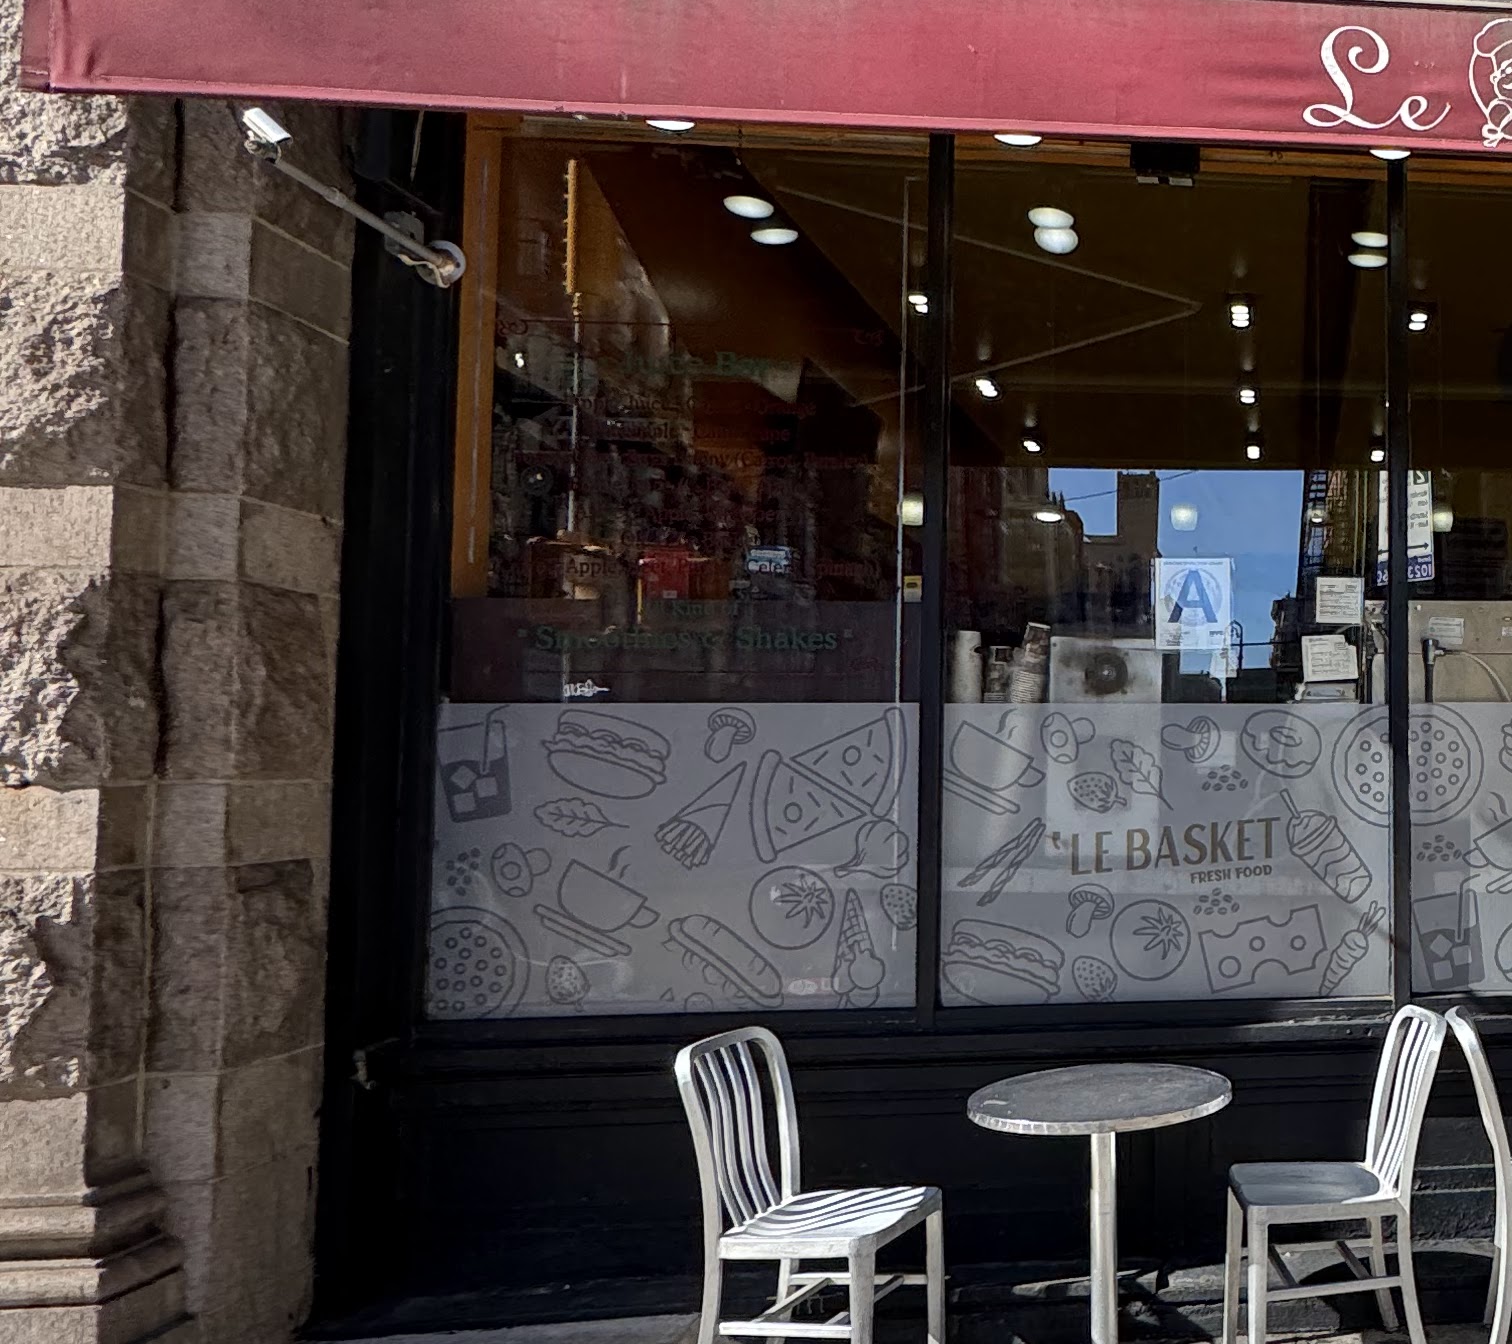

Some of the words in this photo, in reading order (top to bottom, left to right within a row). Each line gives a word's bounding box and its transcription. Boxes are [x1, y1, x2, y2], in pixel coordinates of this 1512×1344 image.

[1302, 25, 1450, 131] Le
[1167, 570, 1218, 623] A
[1126, 816, 1281, 871] BASKET
[1190, 869, 1232, 884] FRESH
[1235, 863, 1273, 879] FOOD
